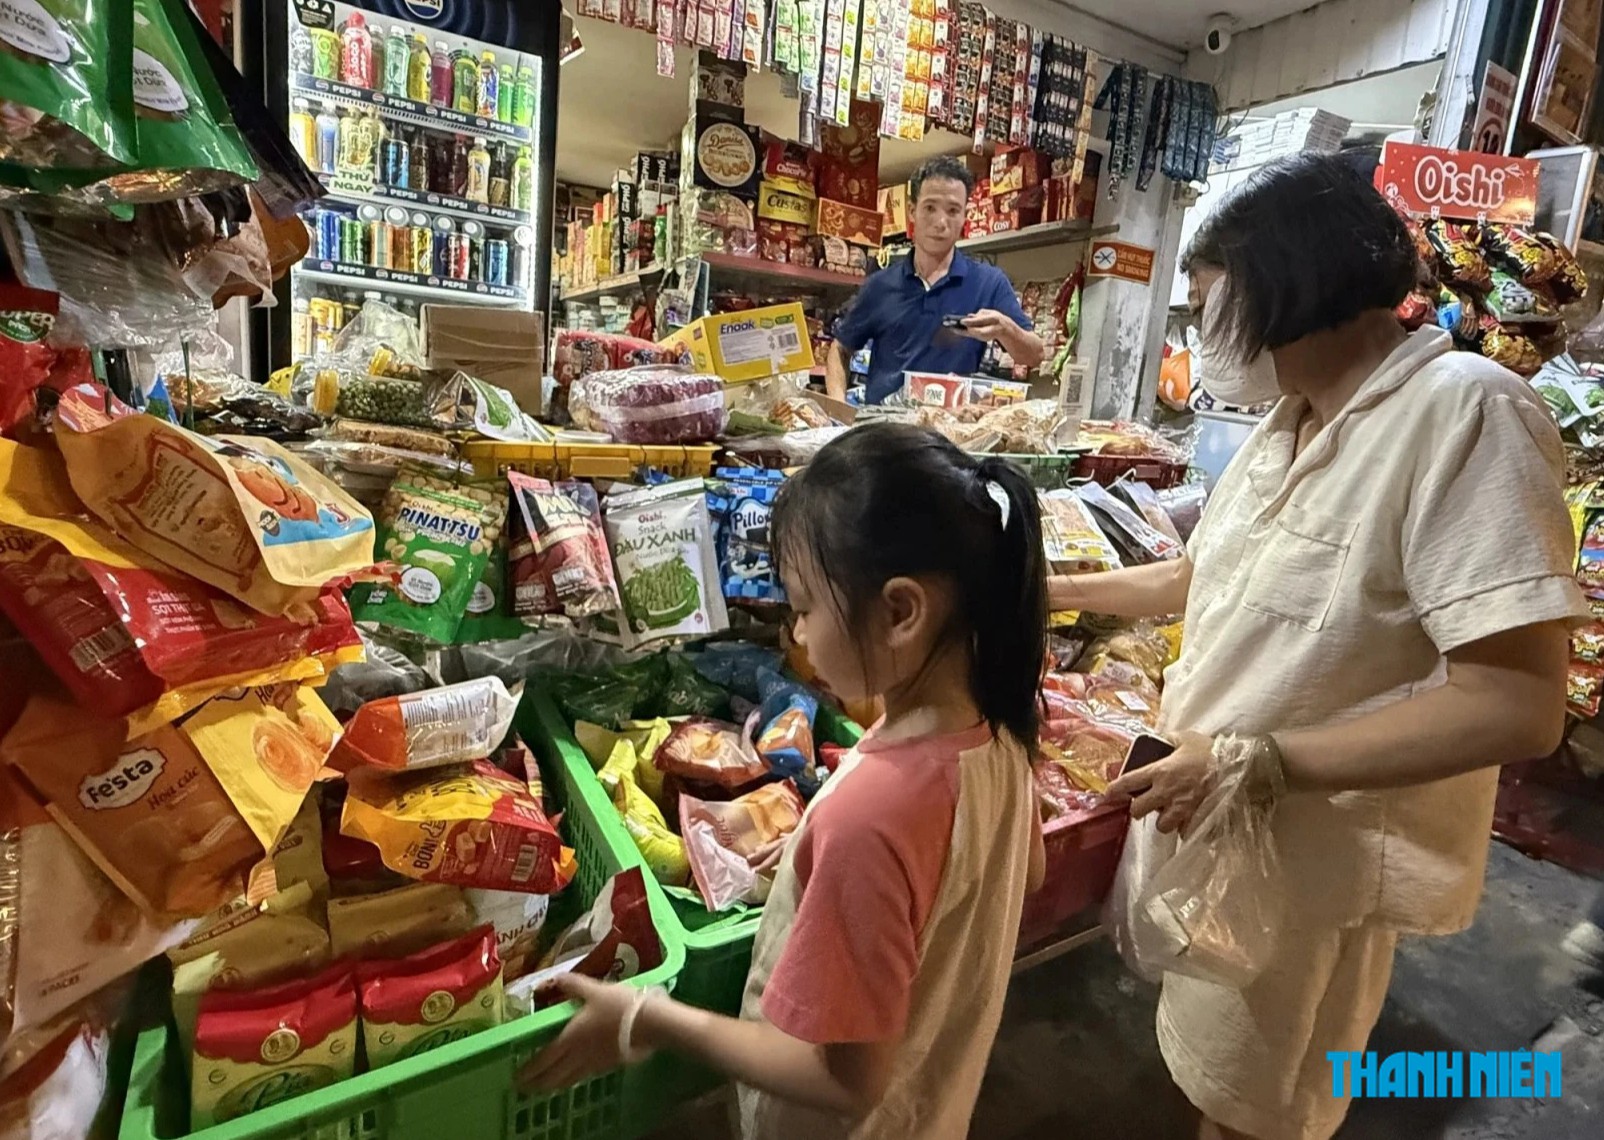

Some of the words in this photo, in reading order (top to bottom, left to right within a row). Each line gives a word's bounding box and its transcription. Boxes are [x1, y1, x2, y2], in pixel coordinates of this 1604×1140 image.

[332, 84, 361, 97] PEPSI
[388, 97, 416, 111] PEPSI
[441, 110, 467, 122] PEPSI
[490, 122, 514, 133] PEPSI
[334, 181, 372, 193] NGAY
[1415, 155, 1506, 209] Oishi
[390, 188, 418, 199] PEPSI
[442, 198, 468, 209] PEPSI
[767, 194, 807, 212] Custas
[491, 208, 516, 218] PEPSI
[337, 264, 365, 276] PEPSI
[391, 272, 418, 283] PEPSI
[442, 280, 468, 290] PEPSI
[490, 287, 515, 297] PEPSI
[638, 510, 663, 524] Oishi
[638, 522, 667, 535] Snack
[647, 527, 696, 549] XANH
